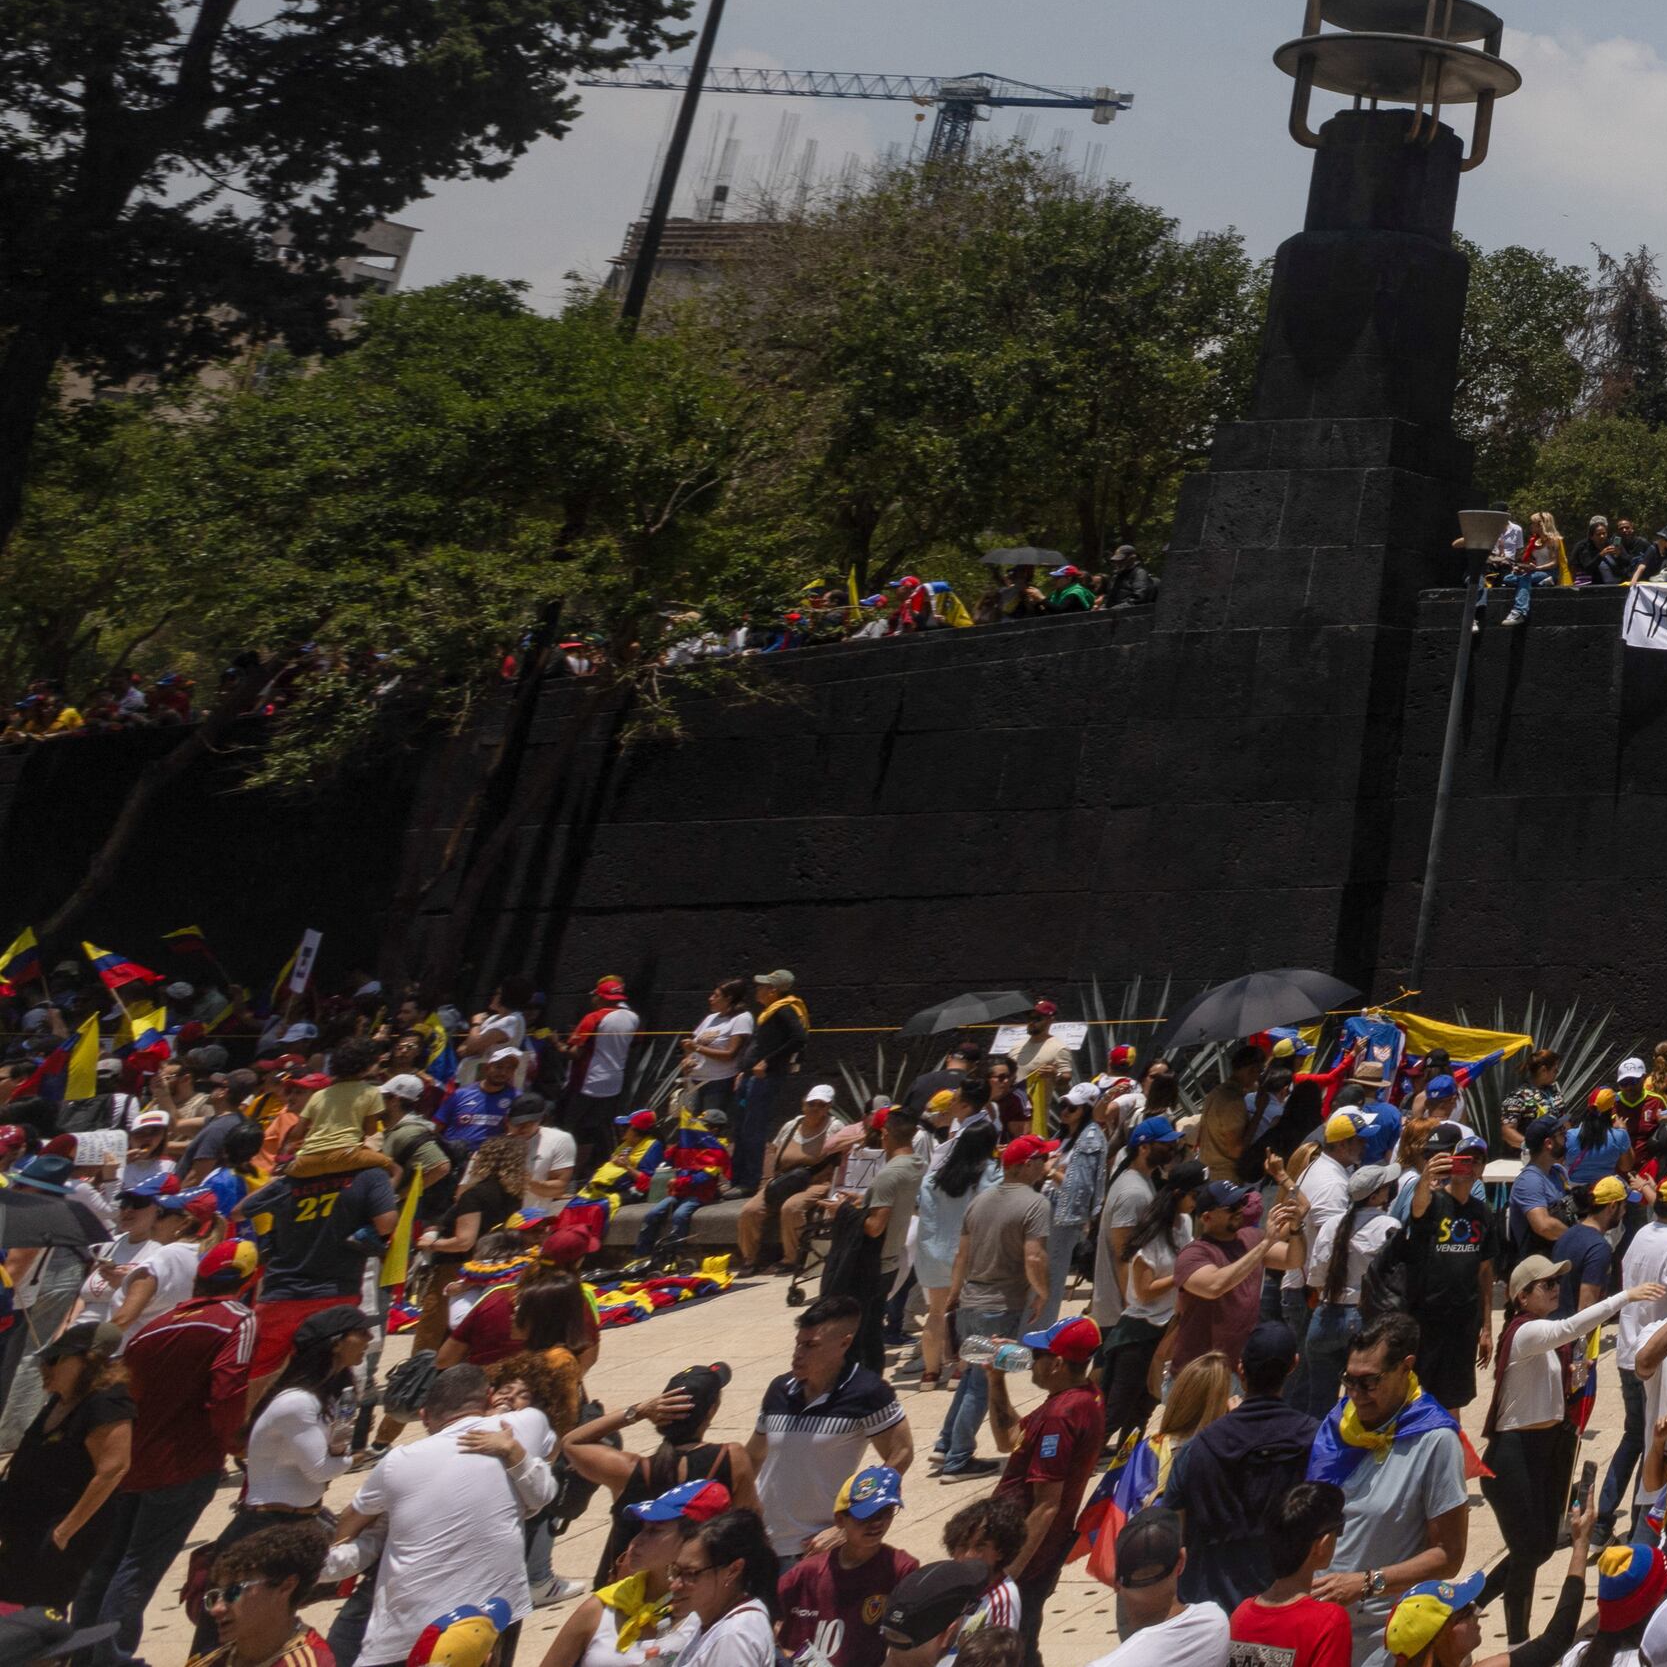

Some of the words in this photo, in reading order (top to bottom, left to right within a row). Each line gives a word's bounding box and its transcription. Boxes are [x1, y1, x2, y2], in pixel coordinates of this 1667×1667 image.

[295, 1191, 341, 1222] 27
[1438, 1217, 1482, 1243] SOS
[1435, 1243, 1480, 1253] VENEZUELA
